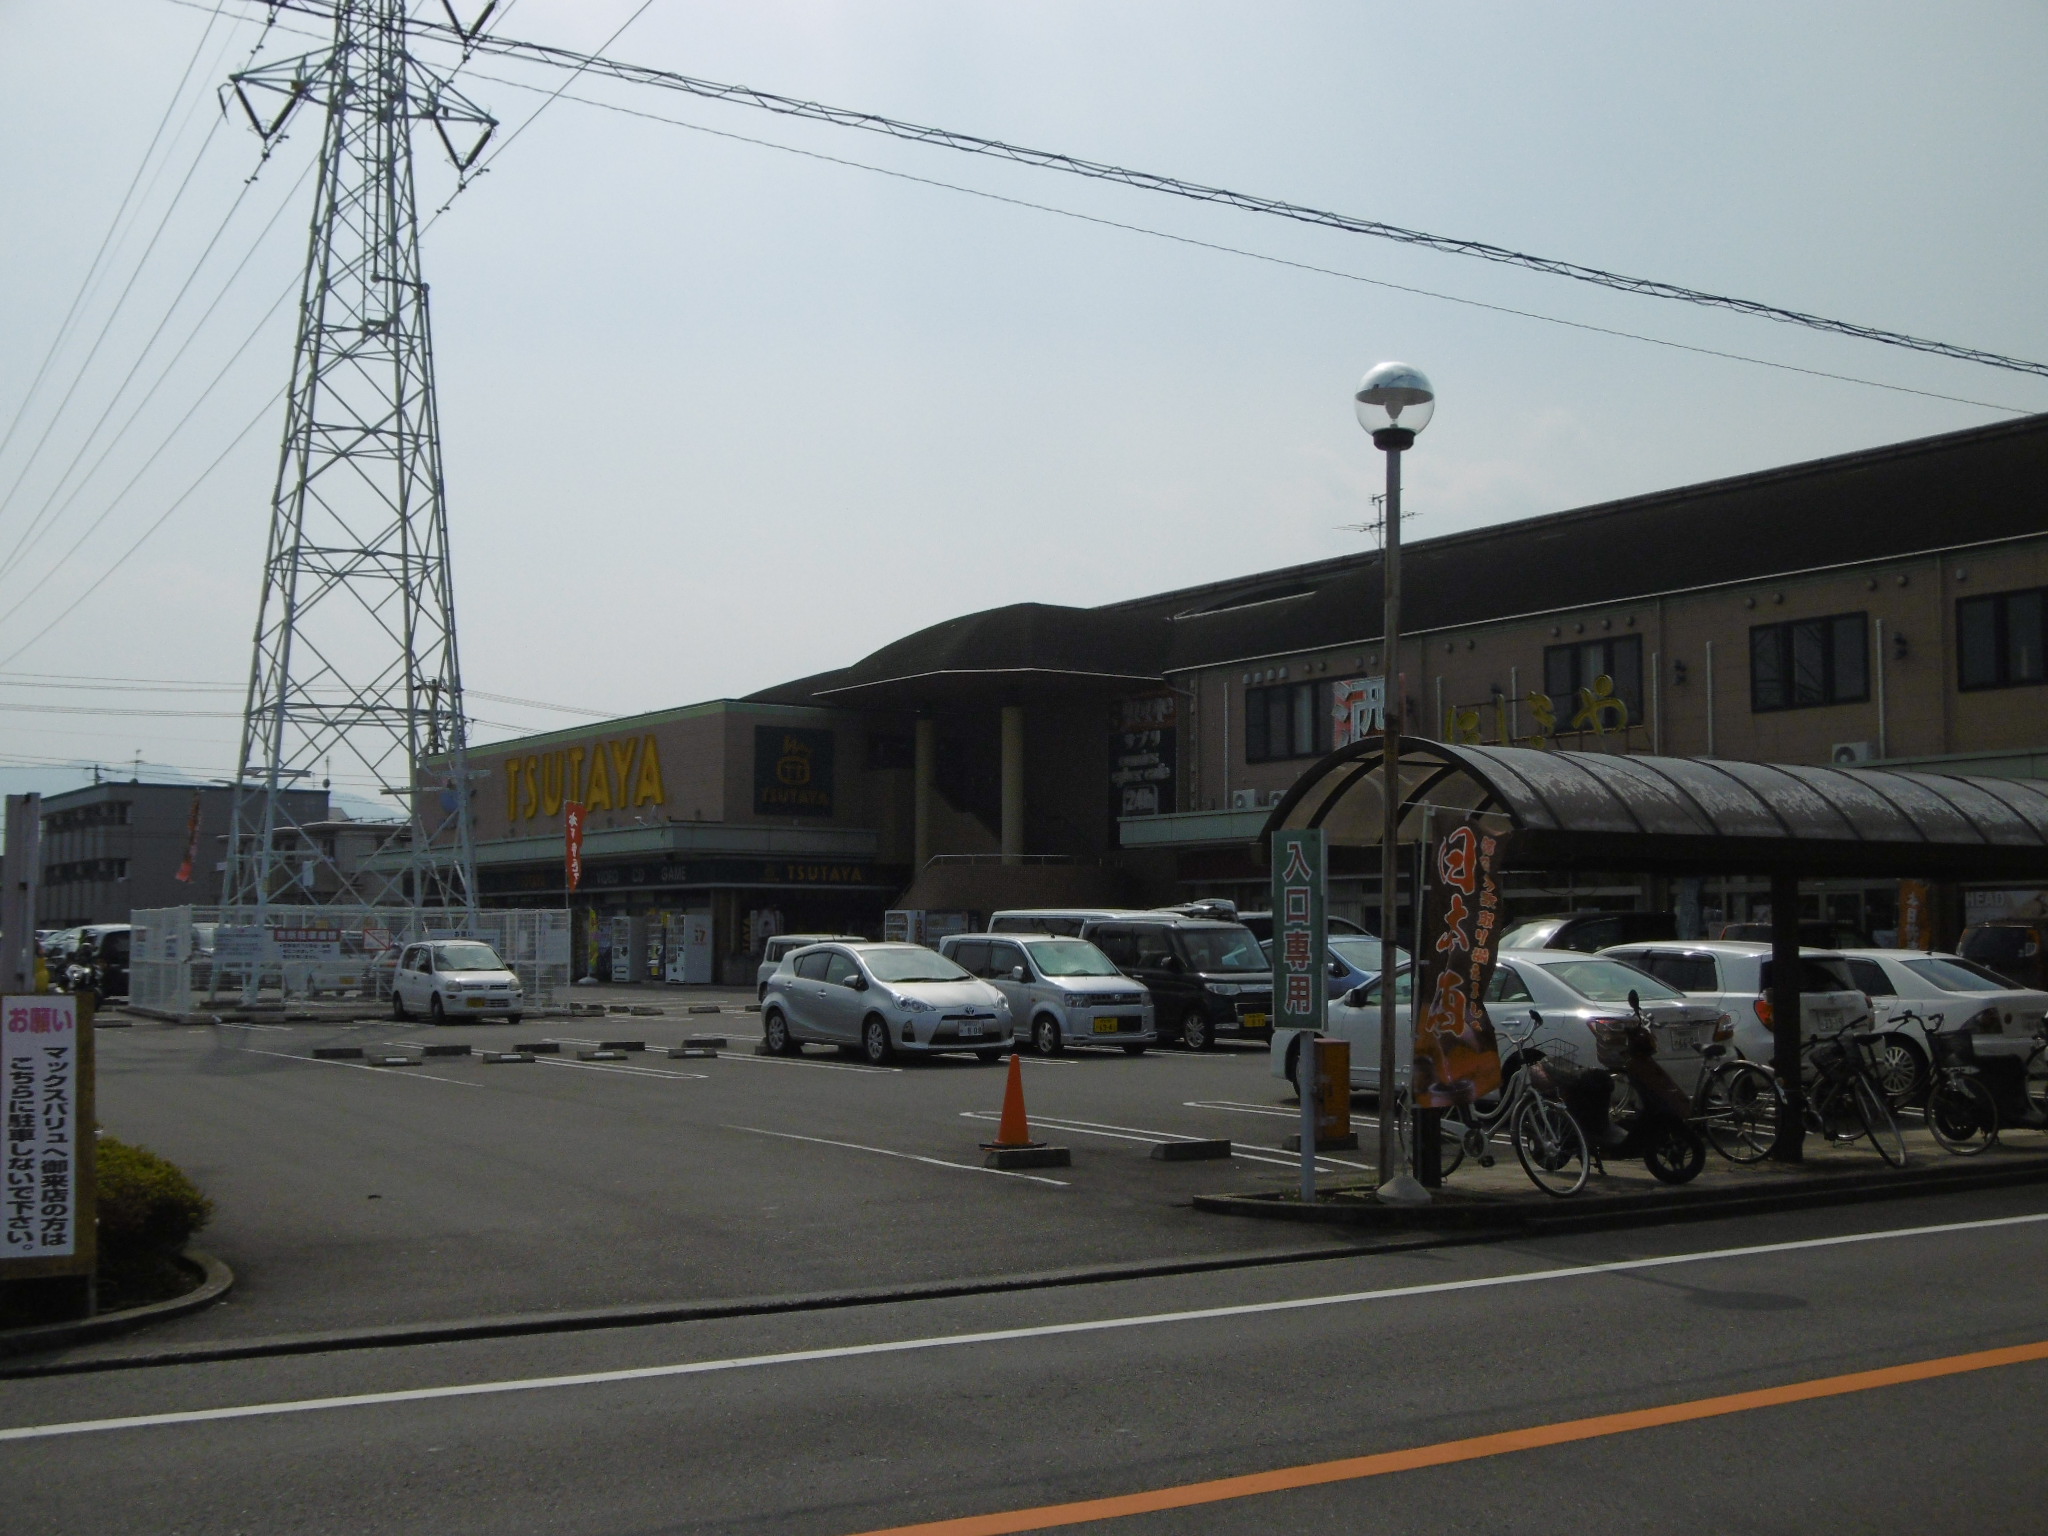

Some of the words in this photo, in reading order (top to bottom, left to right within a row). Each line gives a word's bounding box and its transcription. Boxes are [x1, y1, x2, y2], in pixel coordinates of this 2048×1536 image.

[505, 734, 665, 821] TSUTAYA
[662, 865, 689, 882] GAME
[786, 864, 864, 881] TSUTAYA
[1281, 840, 1313, 1016] 入口専用
[8, 1007, 74, 1034] お願い
[6, 1056, 36, 1251] こちらに駐車しないで下さい。
[41, 1046, 70, 1247] マックスバリュへ御来店の方は
